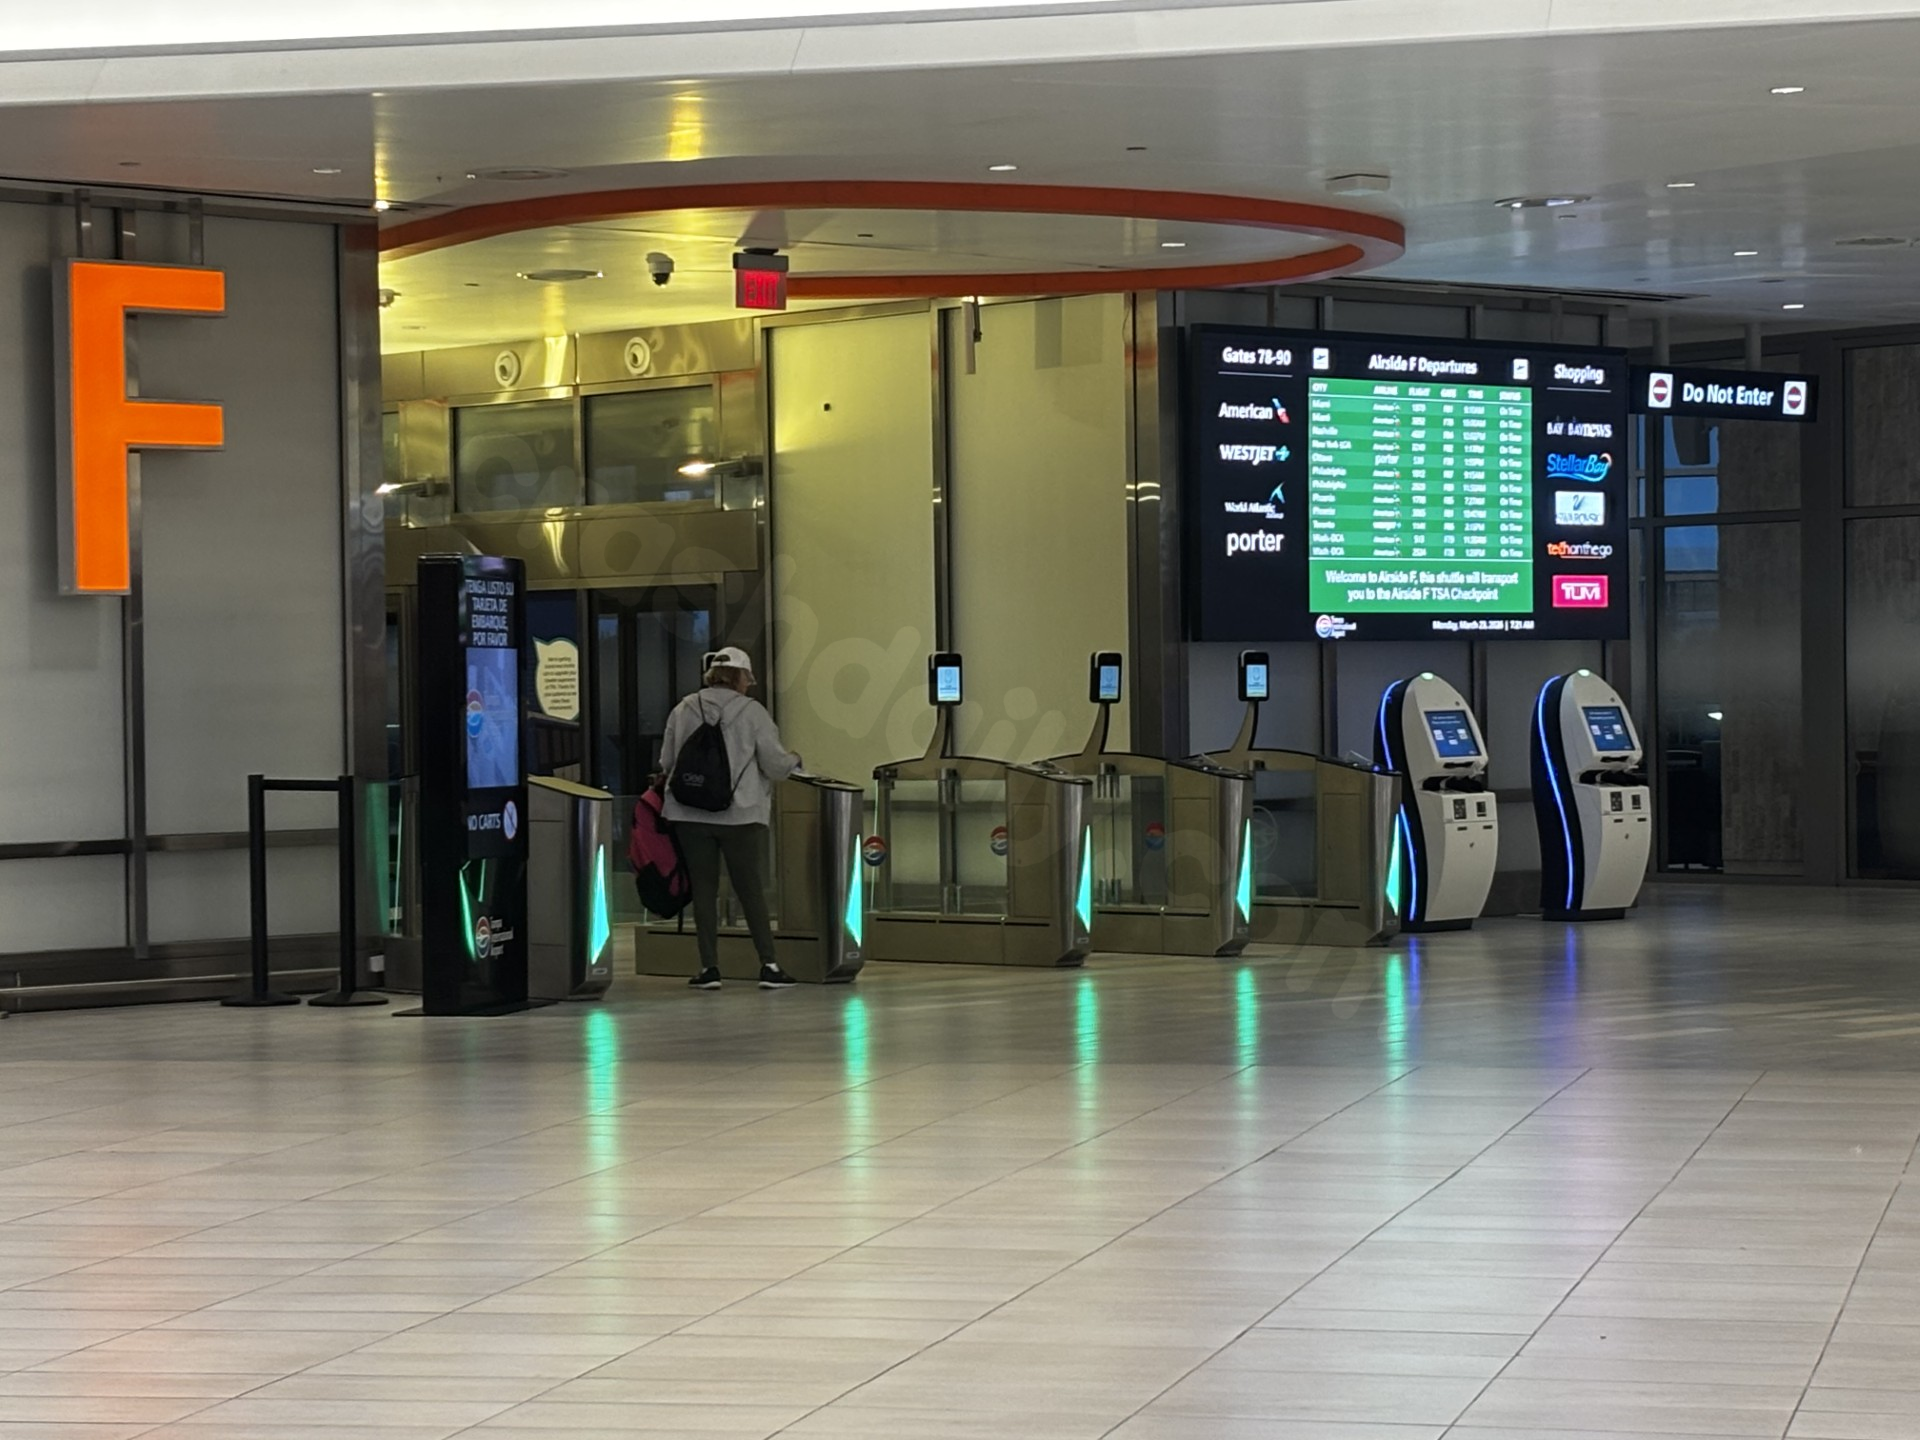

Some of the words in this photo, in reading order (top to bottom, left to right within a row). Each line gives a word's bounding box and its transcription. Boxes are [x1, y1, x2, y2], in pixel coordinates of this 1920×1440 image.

[1222, 346, 1256, 365] Gates
[1258, 348, 1292, 366] 78-90
[1368, 354, 1408, 371] Airside
[1409, 356, 1418, 371] F
[1418, 357, 1478, 376] Departures
[1554, 363, 1605, 385] Shopping
[1682, 382, 1704, 403] Do
[1706, 383, 1734, 404] Not
[1736, 385, 1774, 406] Enter
[1218, 402, 1273, 420] American
[70, 262, 226, 591] F
[1219, 444, 1277, 466] WESTJET
[1226, 529, 1285, 557] porter
[487, 580, 505, 595] LISTO
[1325, 570, 1368, 584] Welcome
[1368, 570, 1378, 584] to
[1378, 570, 1408, 585] Airside
[1481, 572, 1519, 587] transport
[1347, 589, 1365, 602] you
[1366, 588, 1375, 600] to
[1376, 588, 1390, 601] the
[1391, 588, 1422, 601] Airside
[1422, 588, 1430, 601] F
[1431, 588, 1451, 601] TSA
[1451, 588, 1499, 602] Checkpoint
[471, 597, 498, 612] TARJETA
[498, 598, 508, 613] DE
[473, 631, 486, 646] POR
[487, 632, 508, 646] FAVOR
[478, 813, 501, 830] CARTS
